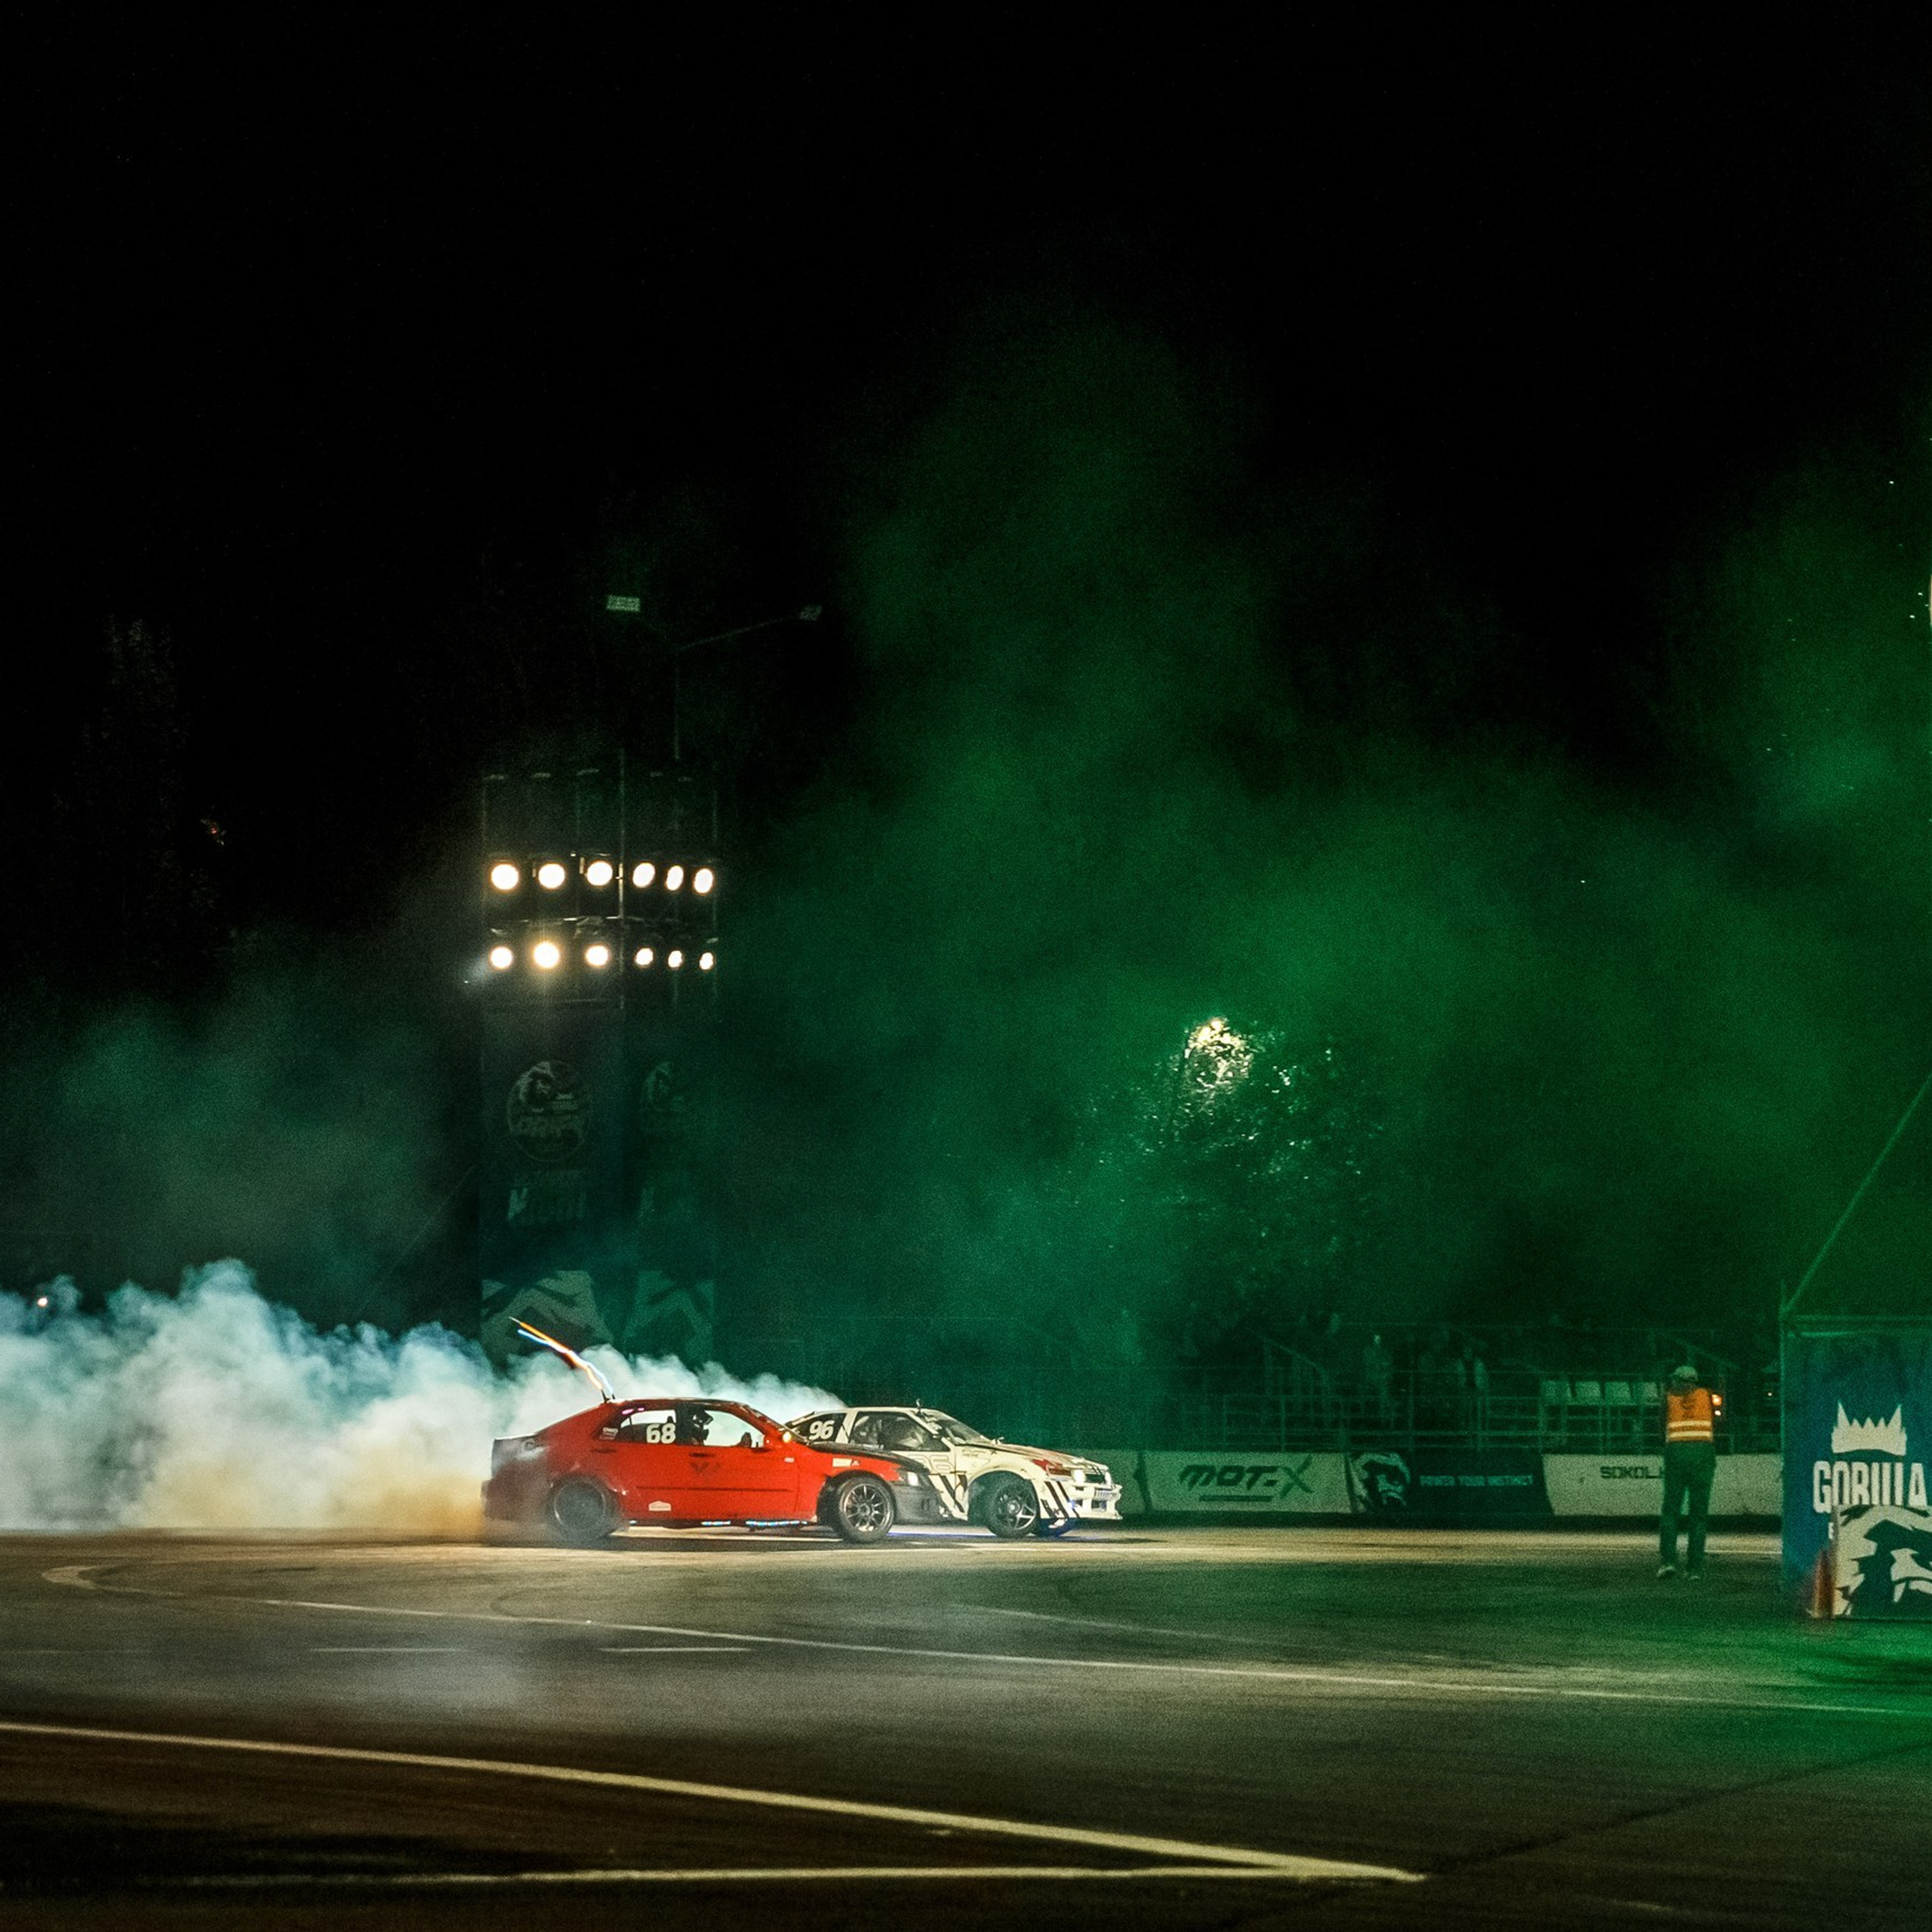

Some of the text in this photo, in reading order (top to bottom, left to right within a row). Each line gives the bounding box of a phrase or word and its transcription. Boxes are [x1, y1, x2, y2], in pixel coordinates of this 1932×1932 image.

[646, 1423, 676, 1444] 68
[808, 1420, 835, 1441] 96
[1813, 1460, 1928, 1514] GORILLA
